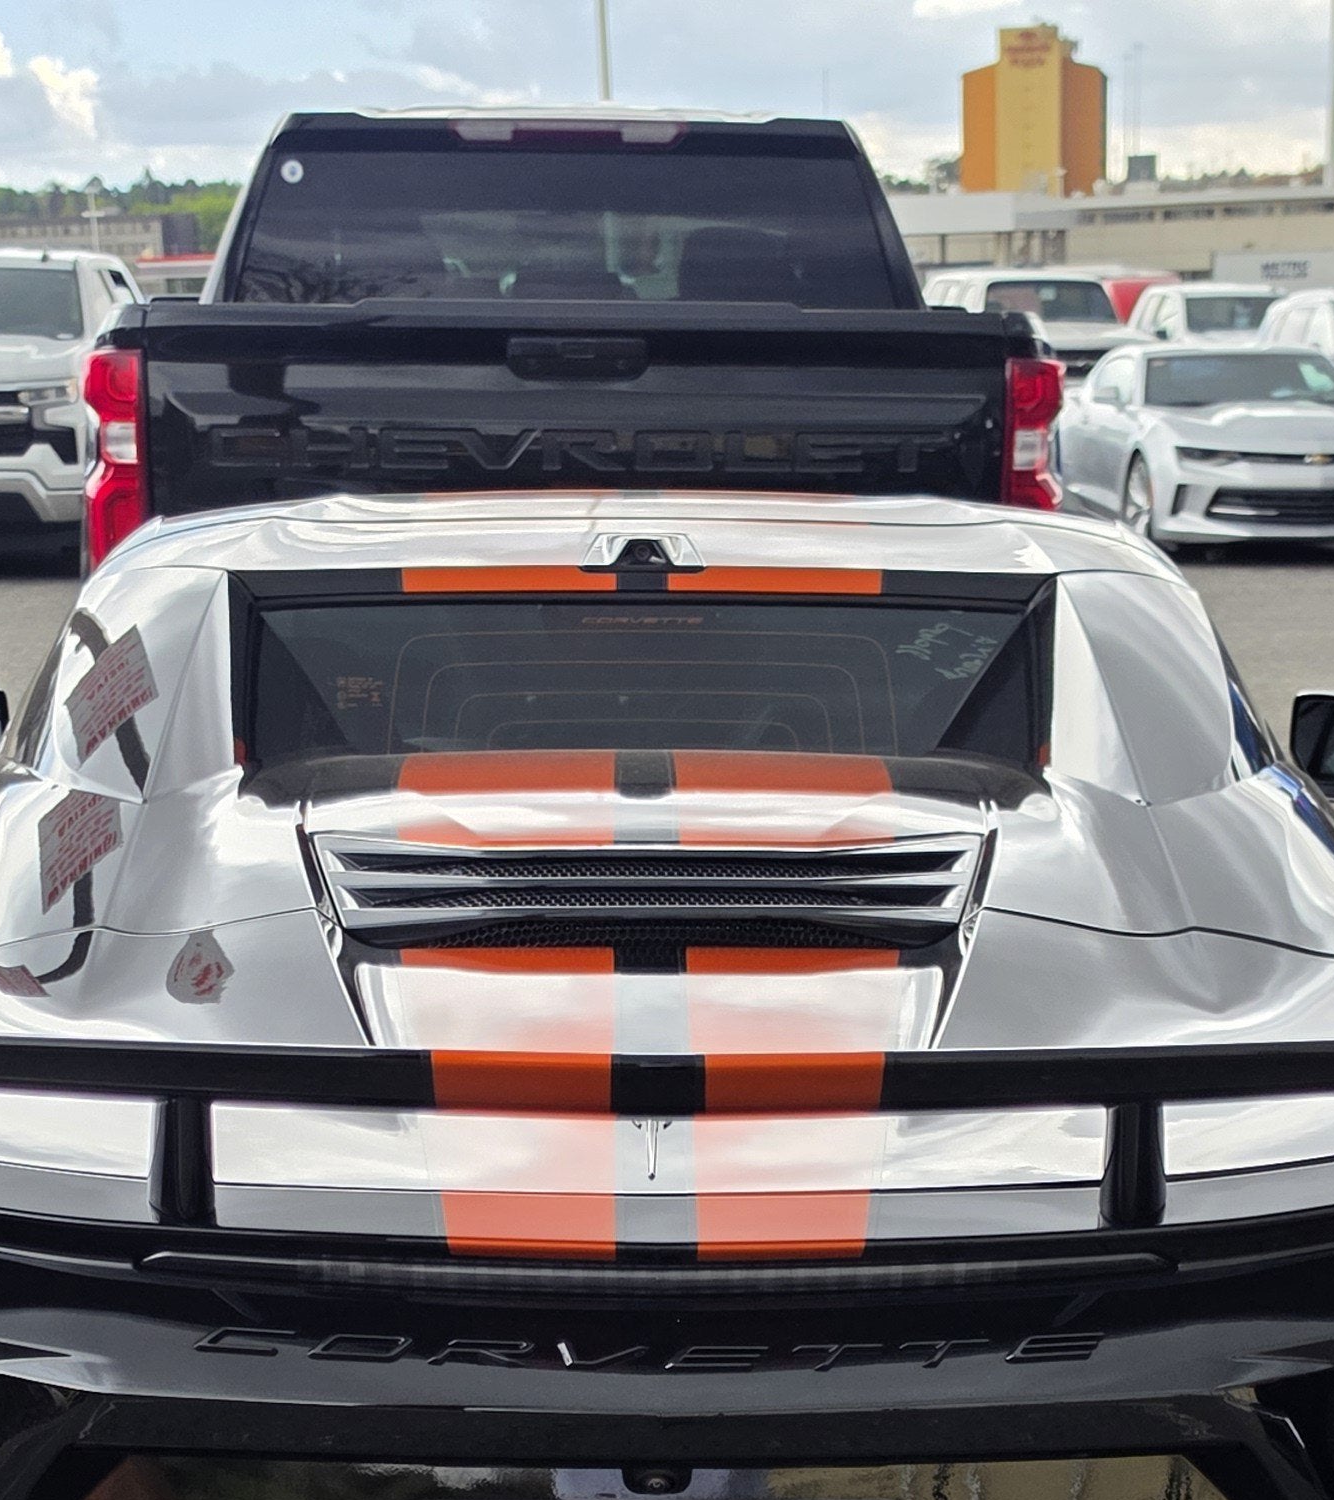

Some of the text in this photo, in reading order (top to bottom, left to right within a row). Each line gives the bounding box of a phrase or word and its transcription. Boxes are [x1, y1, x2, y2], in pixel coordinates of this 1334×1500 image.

[208, 427, 951, 474] CHEVROLET
[582, 616, 704, 625] CORVETTE
[193, 1326, 1105, 1374] CORVETTE
